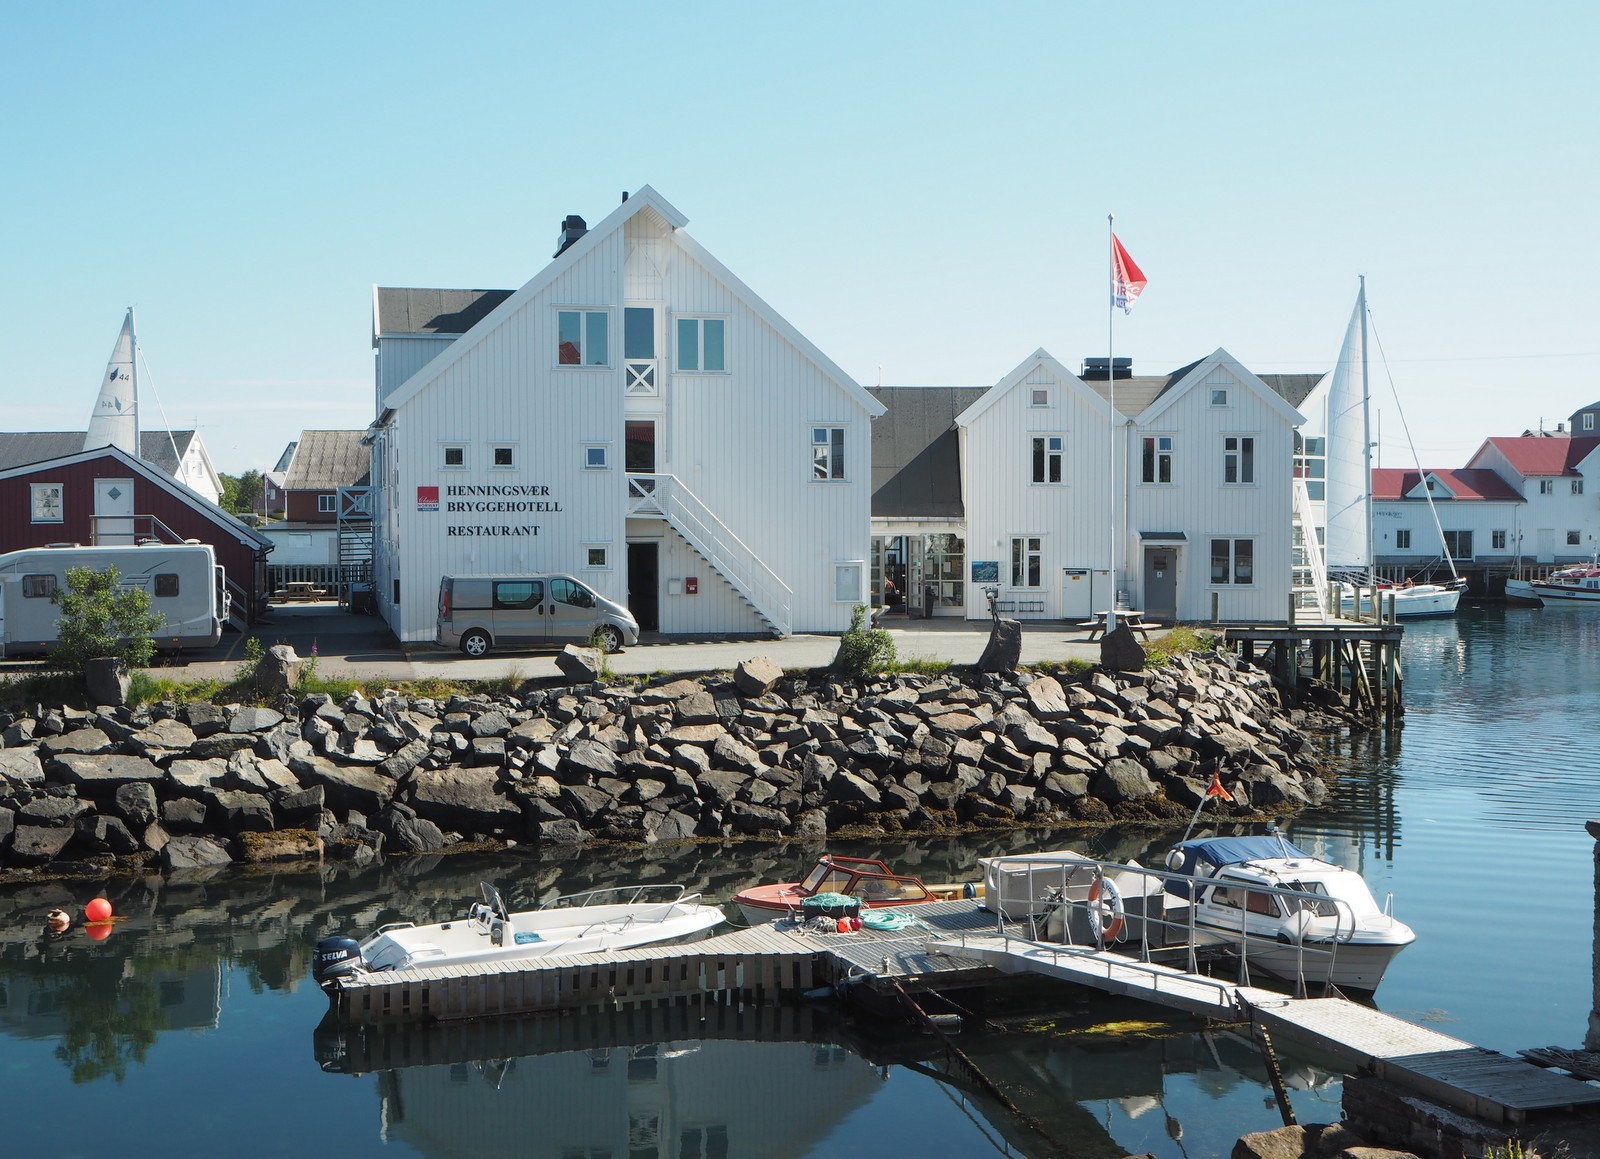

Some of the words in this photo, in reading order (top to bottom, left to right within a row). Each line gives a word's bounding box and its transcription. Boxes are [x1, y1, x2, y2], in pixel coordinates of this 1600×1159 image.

[447, 485, 550, 496] HENNINGSVÆR
[447, 501, 563, 512] BRYGGEHOTELL
[447, 526, 540, 536] RESTAURANT
[322, 950, 347, 961] SELVA
